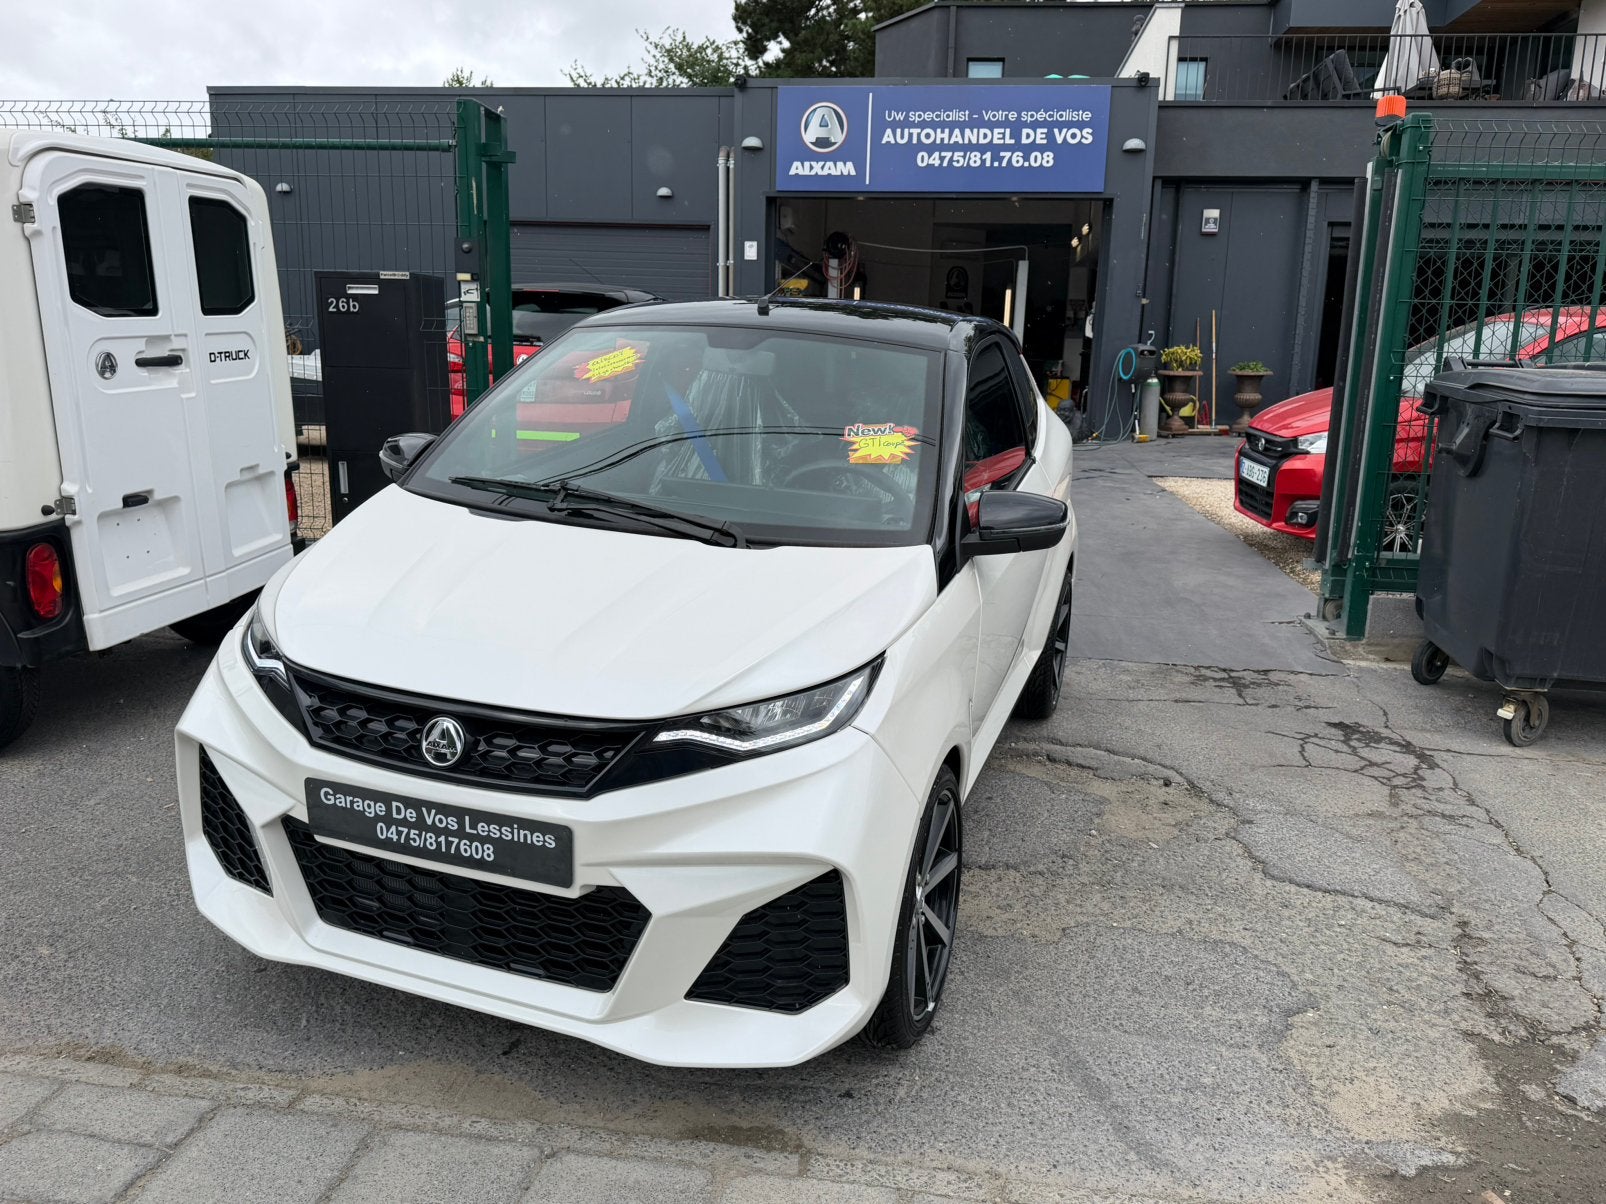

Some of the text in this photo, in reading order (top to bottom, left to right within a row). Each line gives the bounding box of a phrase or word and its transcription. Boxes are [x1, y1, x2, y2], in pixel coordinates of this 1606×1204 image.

[885, 110, 906, 121] Uw
[908, 109, 969, 123] specialist
[982, 110, 1018, 121] Votre
[1020, 108, 1092, 123] spécialiste
[881, 128, 1094, 144] AUTOHANDEL DE VOS
[916, 151, 1055, 167] 0475/81.76.08
[788, 161, 857, 176] AIXAM
[328, 297, 359, 312] 26b
[208, 349, 251, 363] D-TRUCK
[846, 424, 893, 438] New!
[319, 787, 557, 849] Garage De Vos Lessines
[376, 822, 495, 862] 0475/817608
